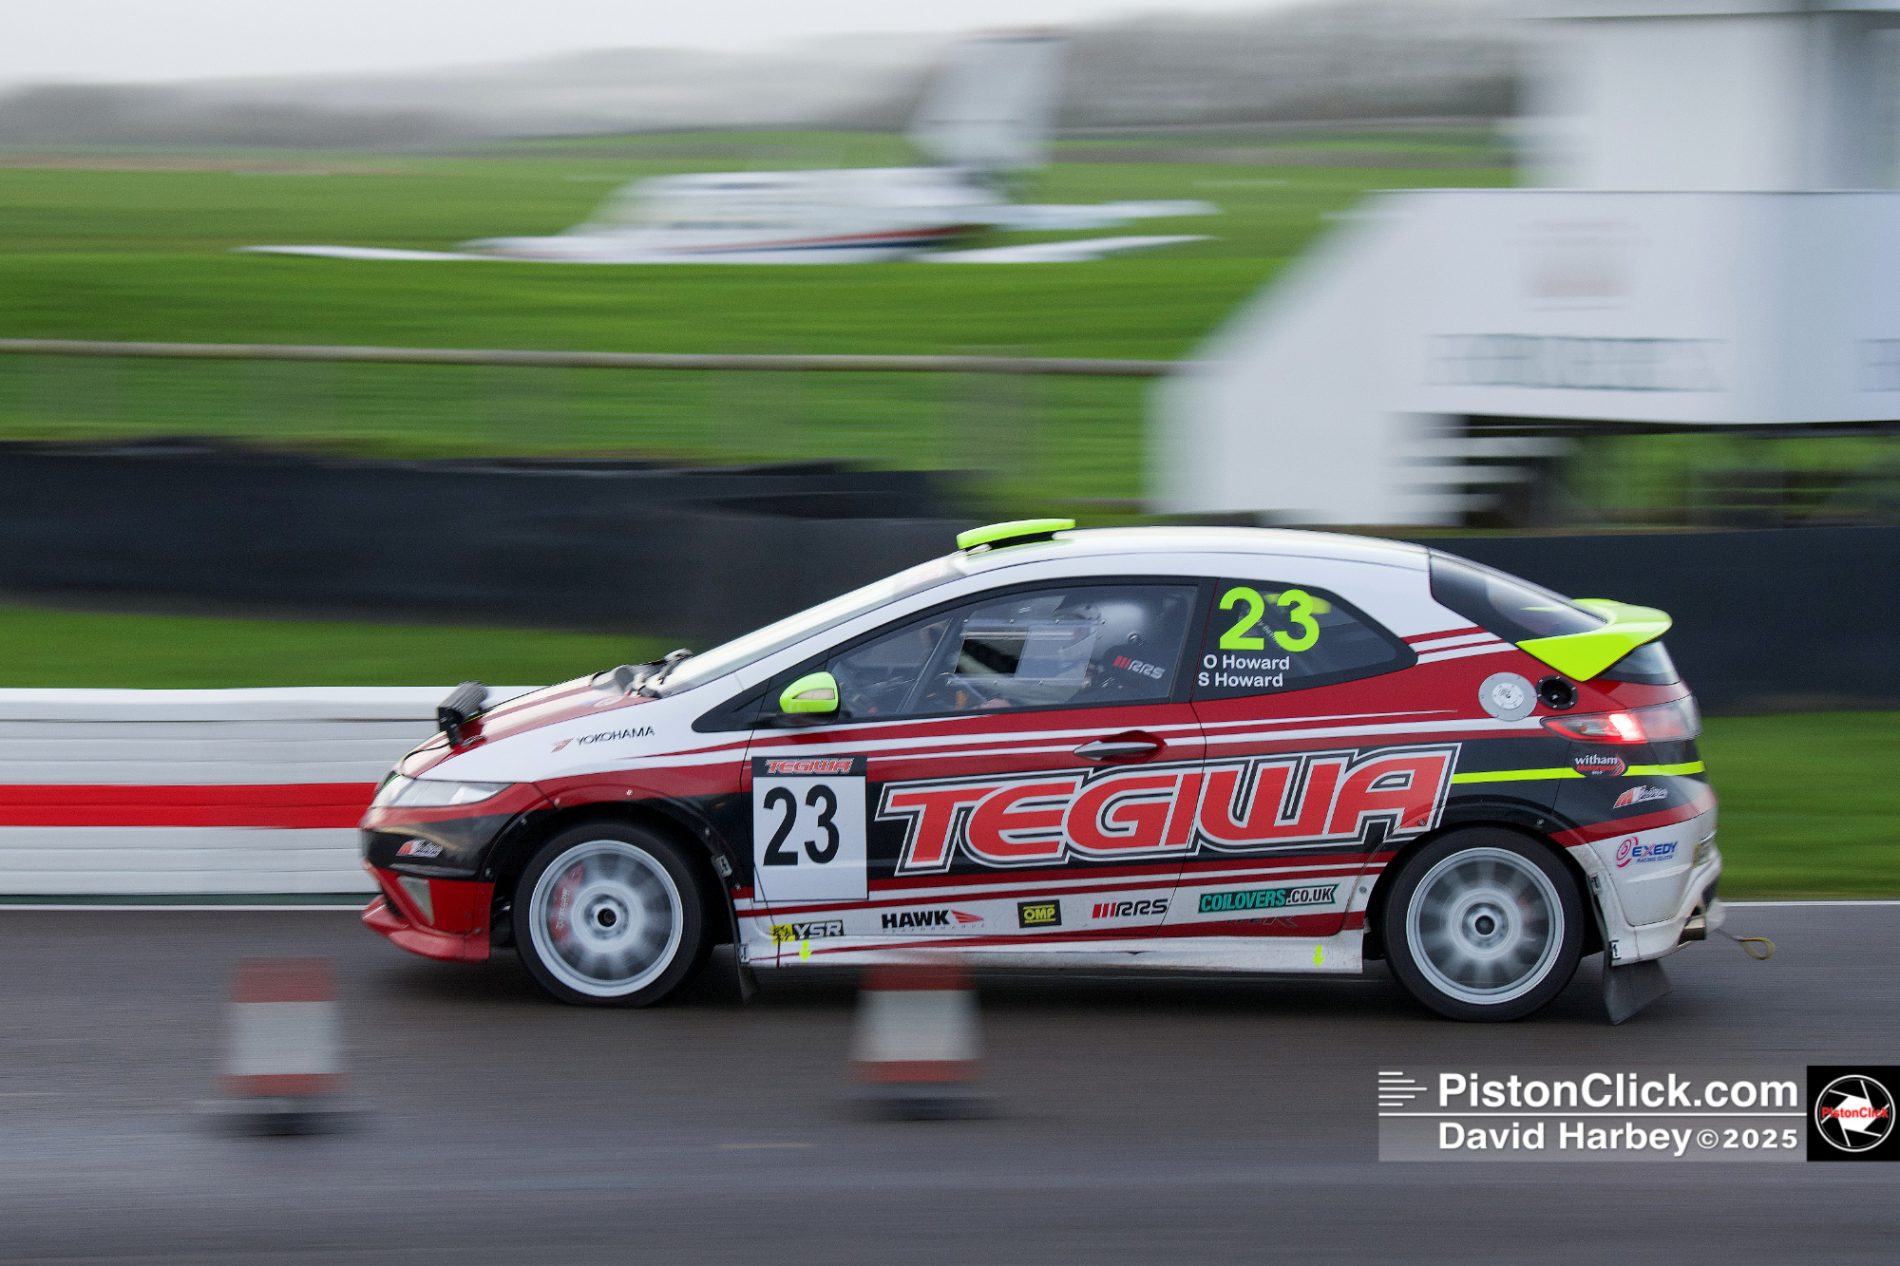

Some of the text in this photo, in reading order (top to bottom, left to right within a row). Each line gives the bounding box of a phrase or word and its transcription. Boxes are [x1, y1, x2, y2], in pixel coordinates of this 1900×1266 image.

[1218, 586, 1320, 652] 23
[1127, 659, 1166, 680] RRS
[1203, 654, 1290, 670] O Howard
[1198, 672, 1284, 687] S Howard
[577, 726, 656, 746] YOKOHAMA
[765, 757, 854, 774] TEGIWA
[1575, 753, 1618, 765] witham
[874, 742, 1461, 878] TEGIWA
[763, 784, 840, 867] 23
[1632, 841, 1678, 857] EXEDY
[1115, 899, 1168, 917] RRS
[1201, 886, 1332, 912] COILOVERS.CO.UK
[881, 910, 950, 929] HAWK
[1023, 907, 1056, 921] OMP
[793, 922, 842, 939] YSR
